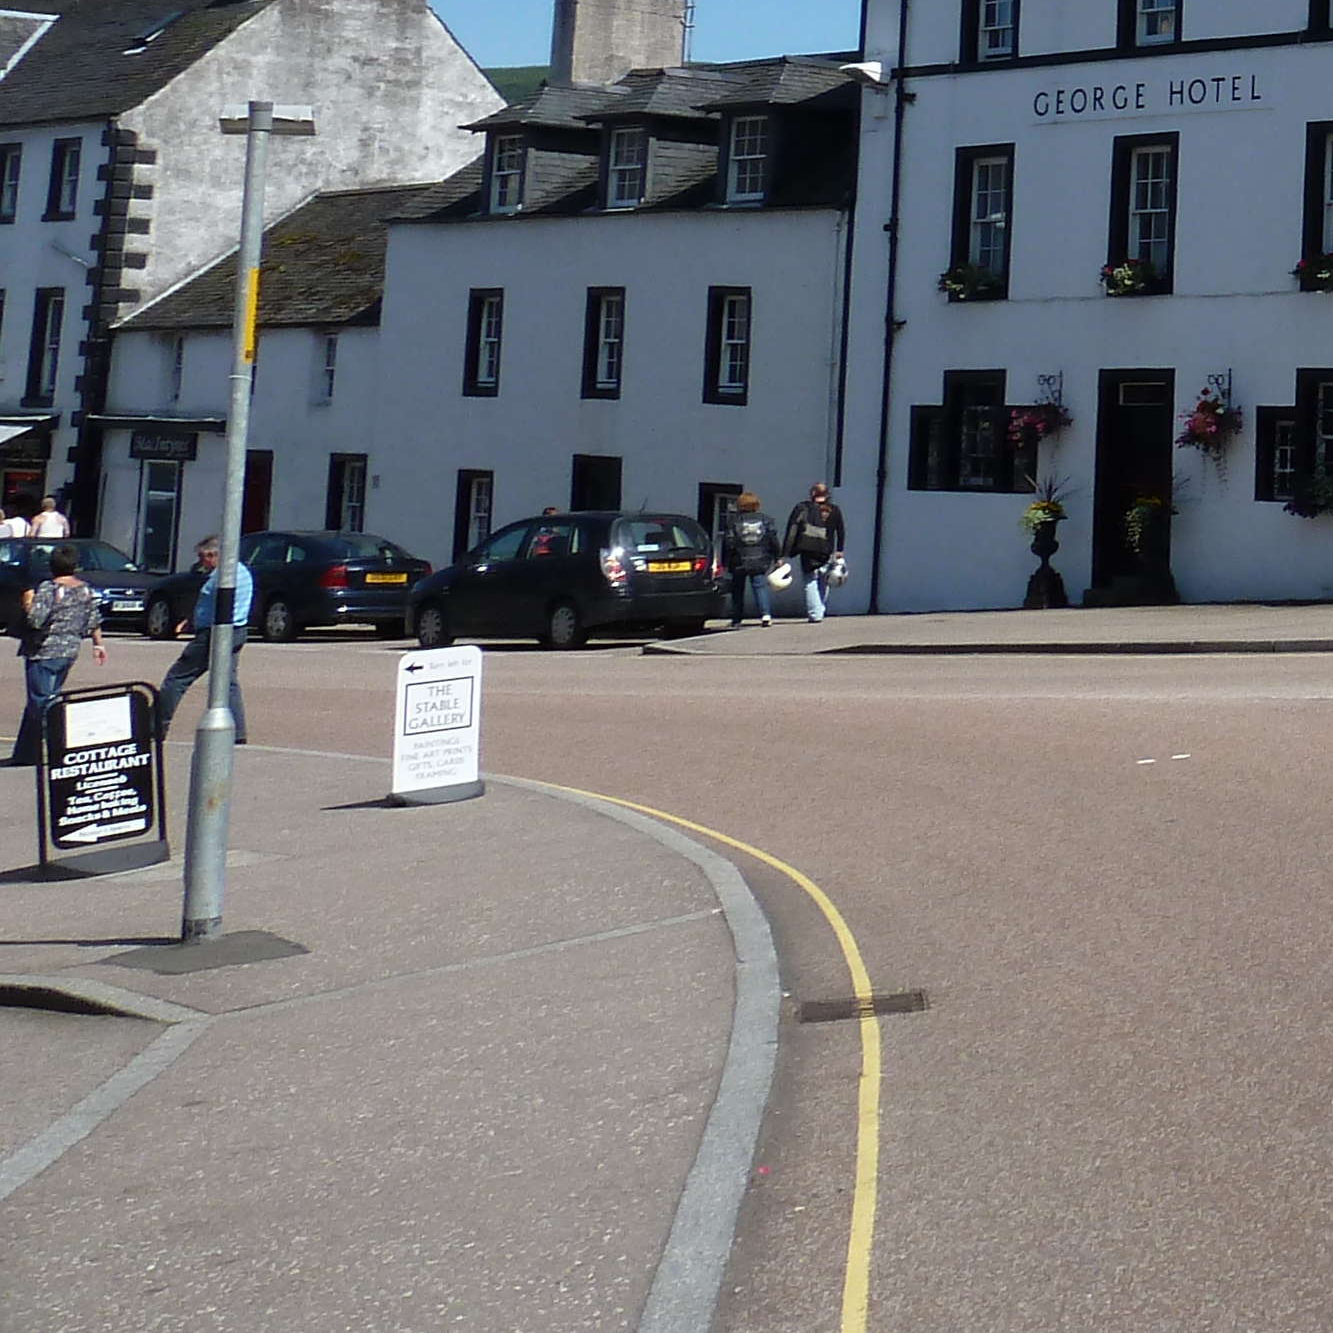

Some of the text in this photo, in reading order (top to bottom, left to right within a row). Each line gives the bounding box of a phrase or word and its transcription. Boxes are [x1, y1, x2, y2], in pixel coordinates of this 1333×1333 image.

[1033, 74, 1262, 117] GEORGE HOTEL
[427, 684, 453, 697] THE
[415, 698, 460, 714] STABLE
[408, 711, 466, 730] GALLERY
[414, 736, 460, 750] PAINTINGS
[63, 743, 138, 765] COTTAGE
[401, 745, 472, 762] FINE ART PRINTS
[50, 753, 151, 780] RESTAURANT
